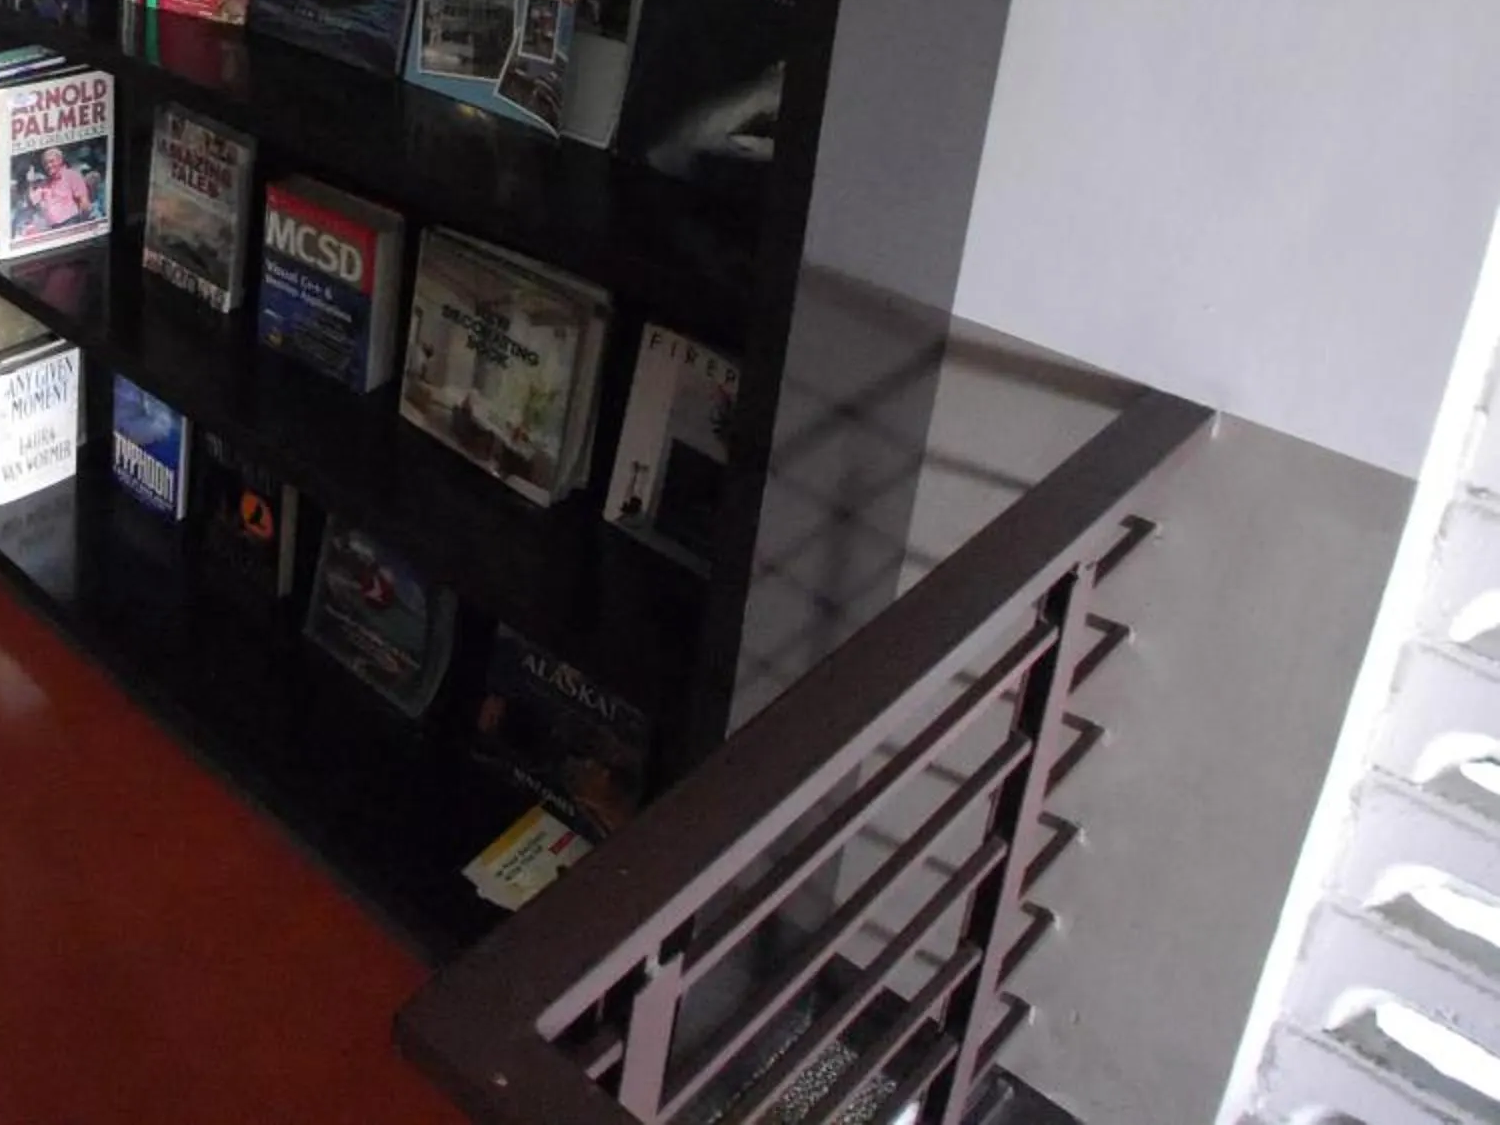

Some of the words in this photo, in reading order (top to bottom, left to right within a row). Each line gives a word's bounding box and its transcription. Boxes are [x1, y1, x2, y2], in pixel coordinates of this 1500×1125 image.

[12, 102, 107, 141] PALMER
[263, 208, 365, 283] MCSD
[11, 382, 68, 421] MOMENT
[112, 429, 176, 505] TYPHOON
